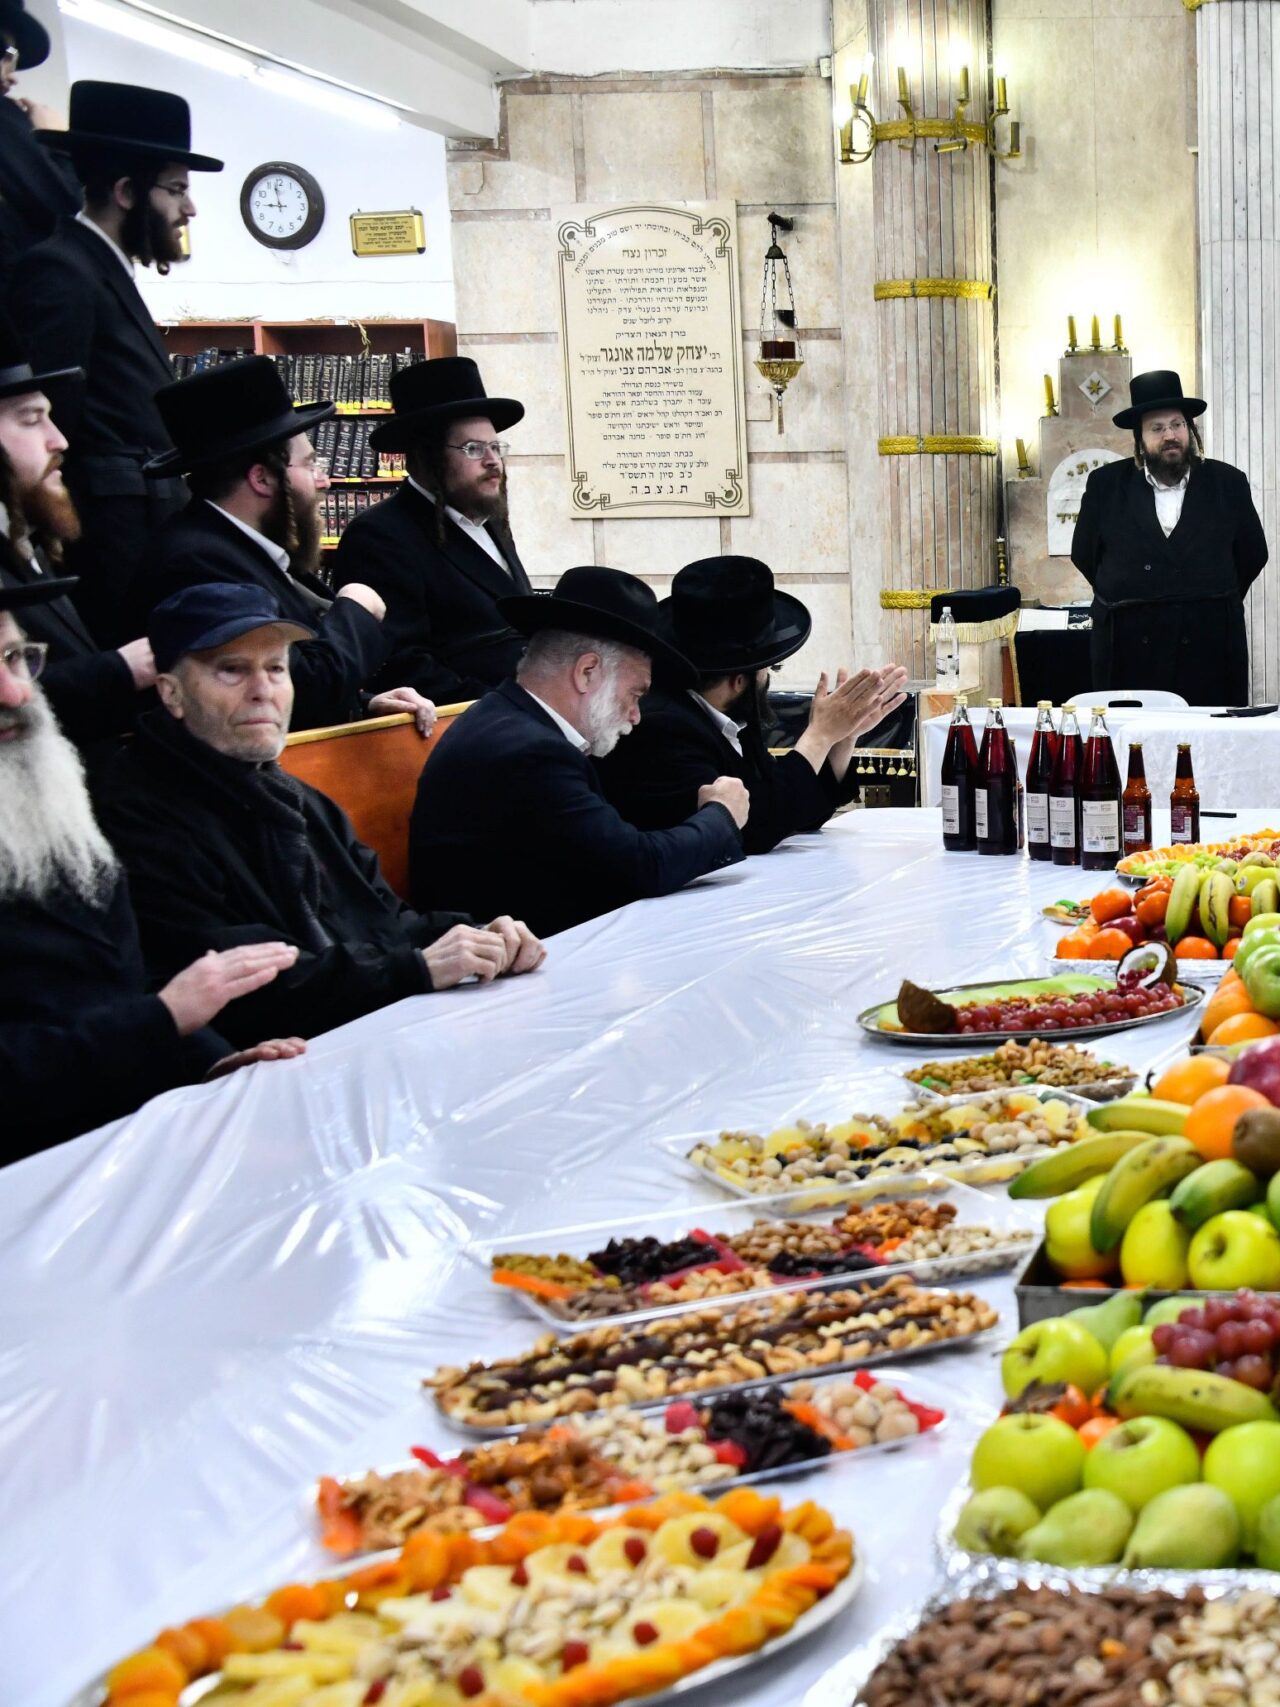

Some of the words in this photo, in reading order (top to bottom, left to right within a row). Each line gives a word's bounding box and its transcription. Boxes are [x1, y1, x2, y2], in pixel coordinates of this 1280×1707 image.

[267, 181, 271, 189] 11
[276, 178, 283, 186] 12
[300, 203, 305, 211] 3
[289, 222, 294, 230] 5
[622, 248, 640, 258] נצח
[644, 248, 667, 261] זכרון
[637, 339, 673, 360] שלמה
[600, 348, 633, 362] אונגר
[677, 345, 707, 365] יצחק
[620, 367, 634, 375] צבי
[638, 366, 671, 375] אברהם
